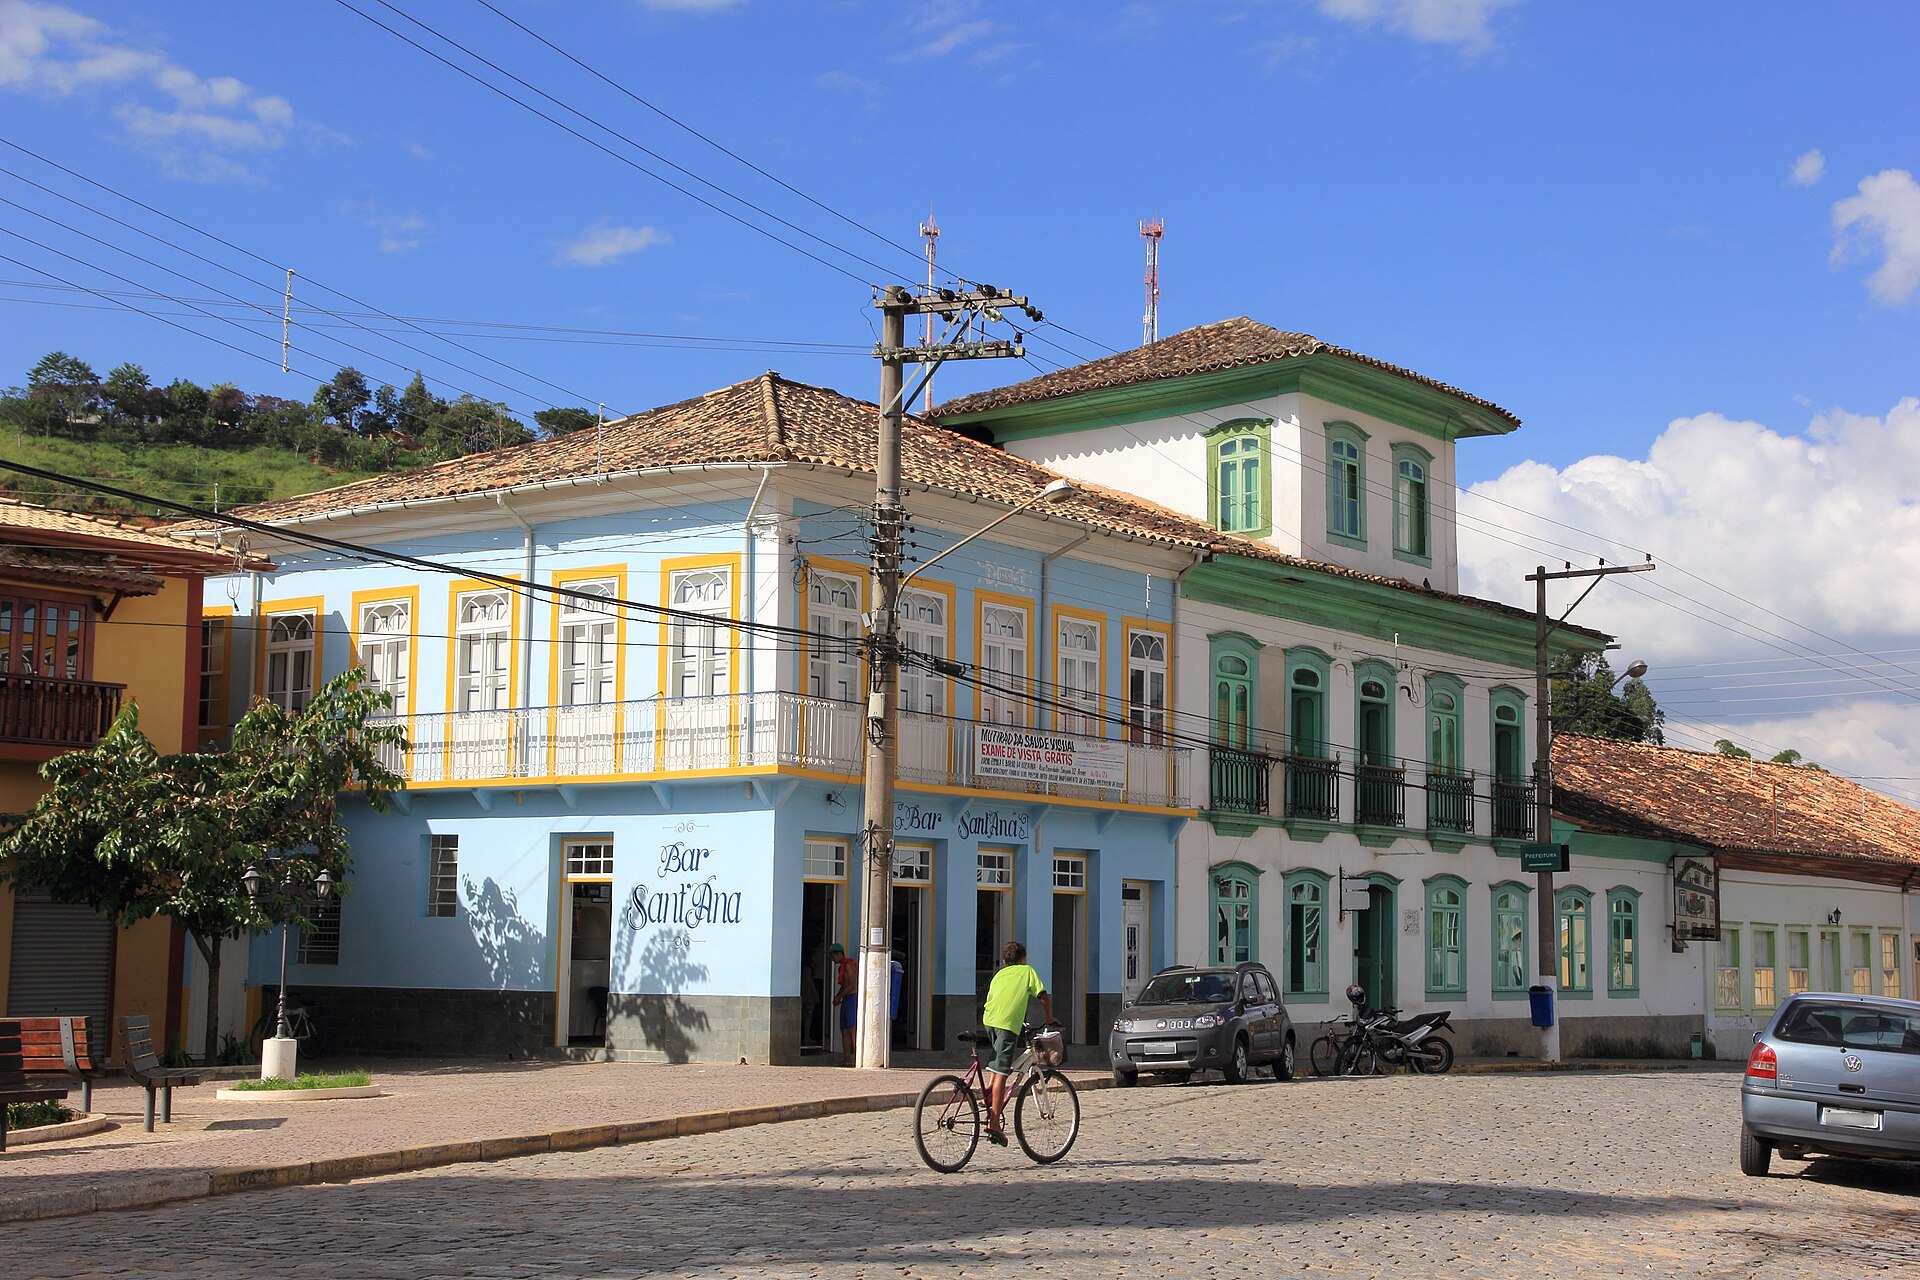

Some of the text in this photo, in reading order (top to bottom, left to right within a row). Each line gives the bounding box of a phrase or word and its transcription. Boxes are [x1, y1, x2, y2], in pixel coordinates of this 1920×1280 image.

[981, 743, 1006, 758] EXAME
[1007, 746, 1016, 759] DE
[1017, 748, 1042, 762] VISTA
[1013, 733, 1024, 747] DA
[1050, 738, 1077, 753] VISUAL
[904, 804, 1018, 840] Bar Sant'Ana
[657, 842, 716, 878] Bar
[627, 875, 743, 930] Sant'Ana
